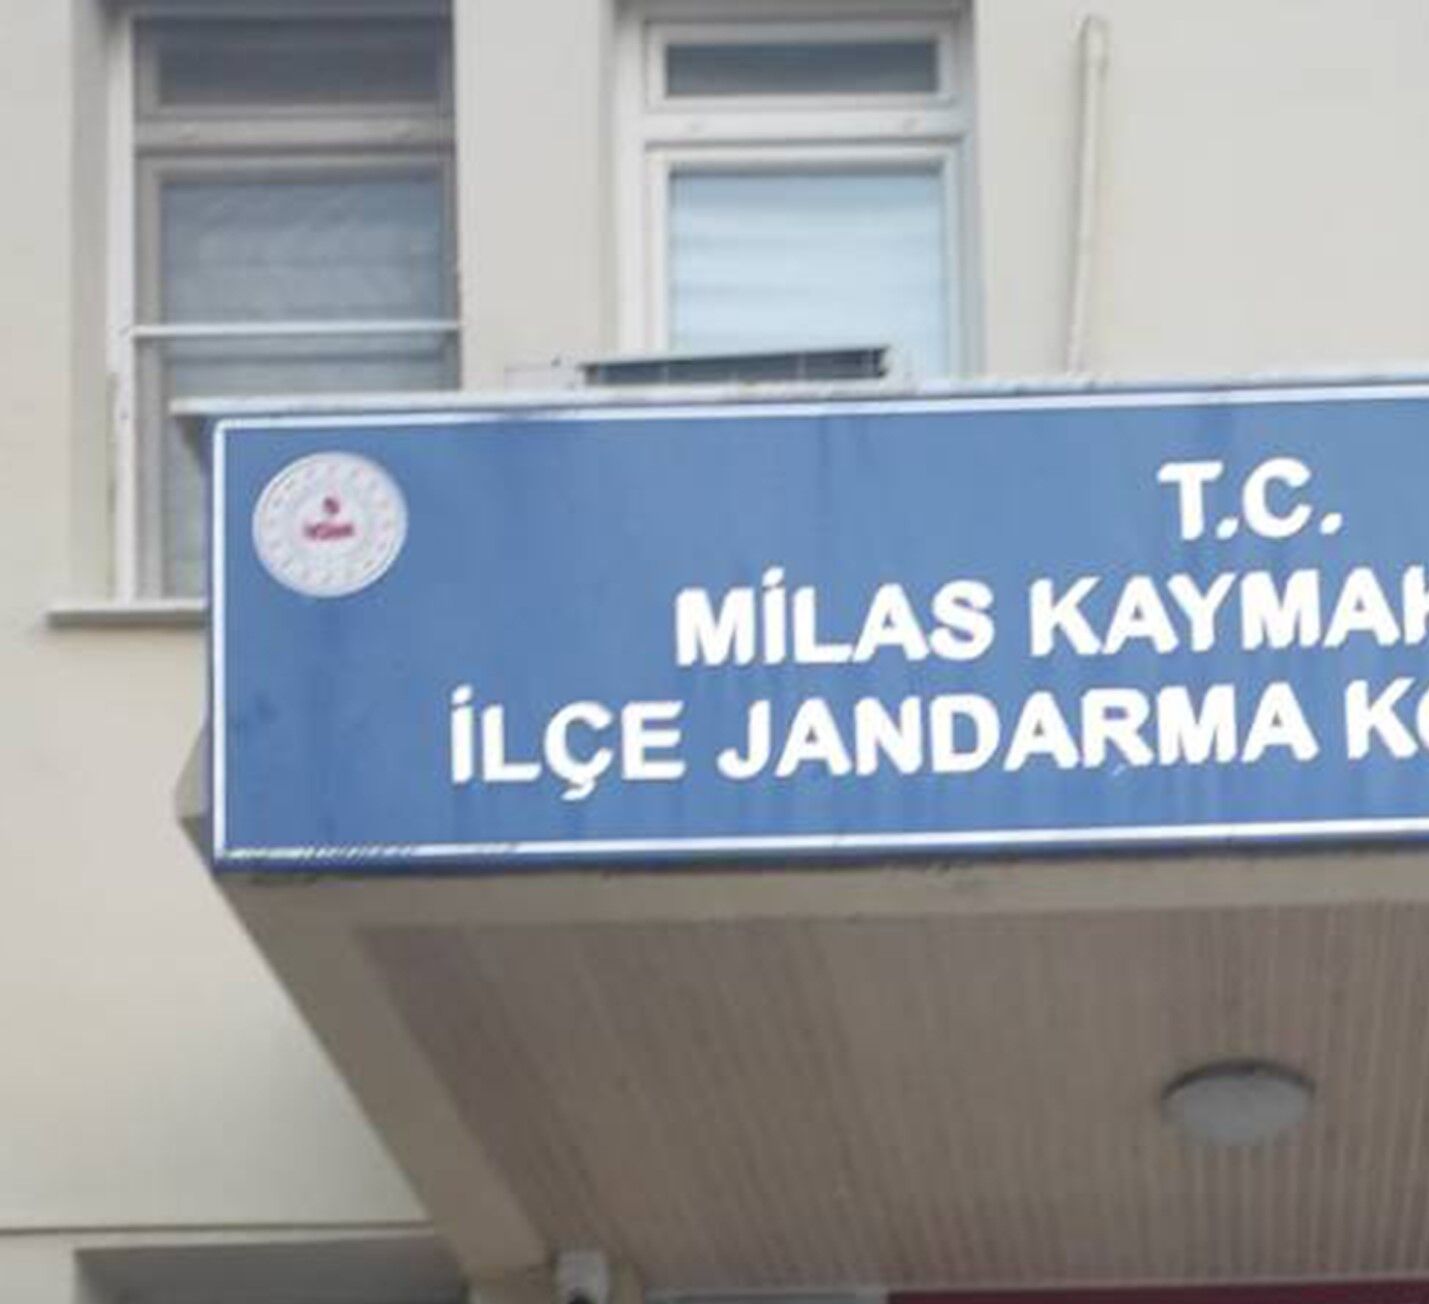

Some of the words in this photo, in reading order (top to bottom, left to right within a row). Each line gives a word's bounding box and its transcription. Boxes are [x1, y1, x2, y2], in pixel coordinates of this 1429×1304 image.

[1156, 457, 1343, 541] T.C.
[675, 567, 997, 666] MİLAS
[450, 685, 686, 801] İLÇE
[716, 680, 1321, 780] JANDARMA
